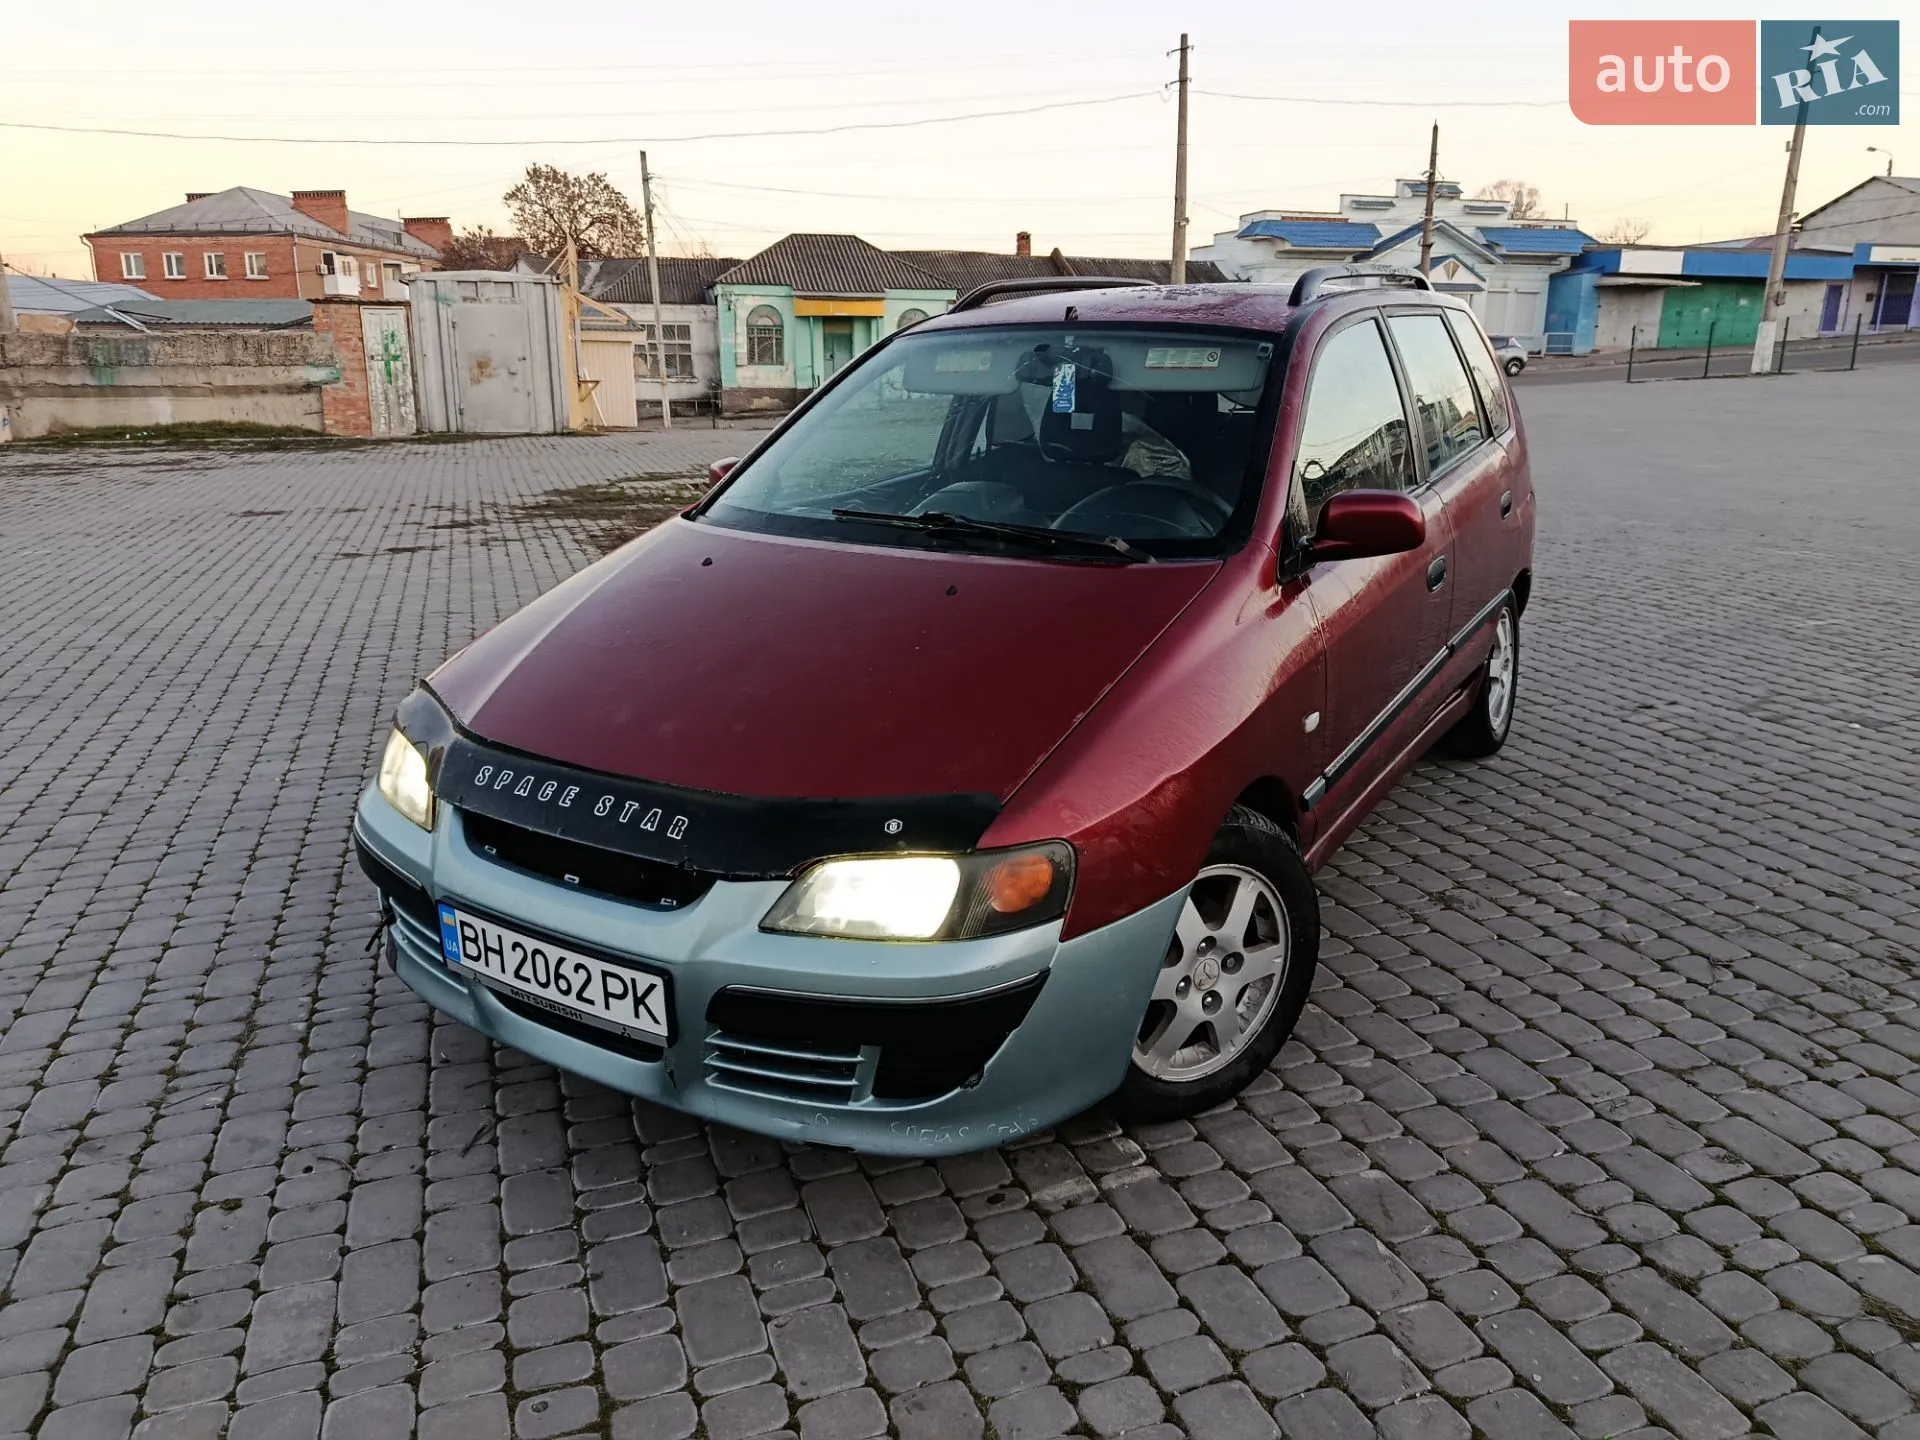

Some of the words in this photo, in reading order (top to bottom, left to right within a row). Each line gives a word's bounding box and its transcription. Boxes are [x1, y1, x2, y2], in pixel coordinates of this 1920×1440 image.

[475, 766, 579, 807] SPACE
[595, 796, 688, 839] STAR
[446, 939, 459, 954] UA
[511, 989, 583, 1020] MITSUBISHI
